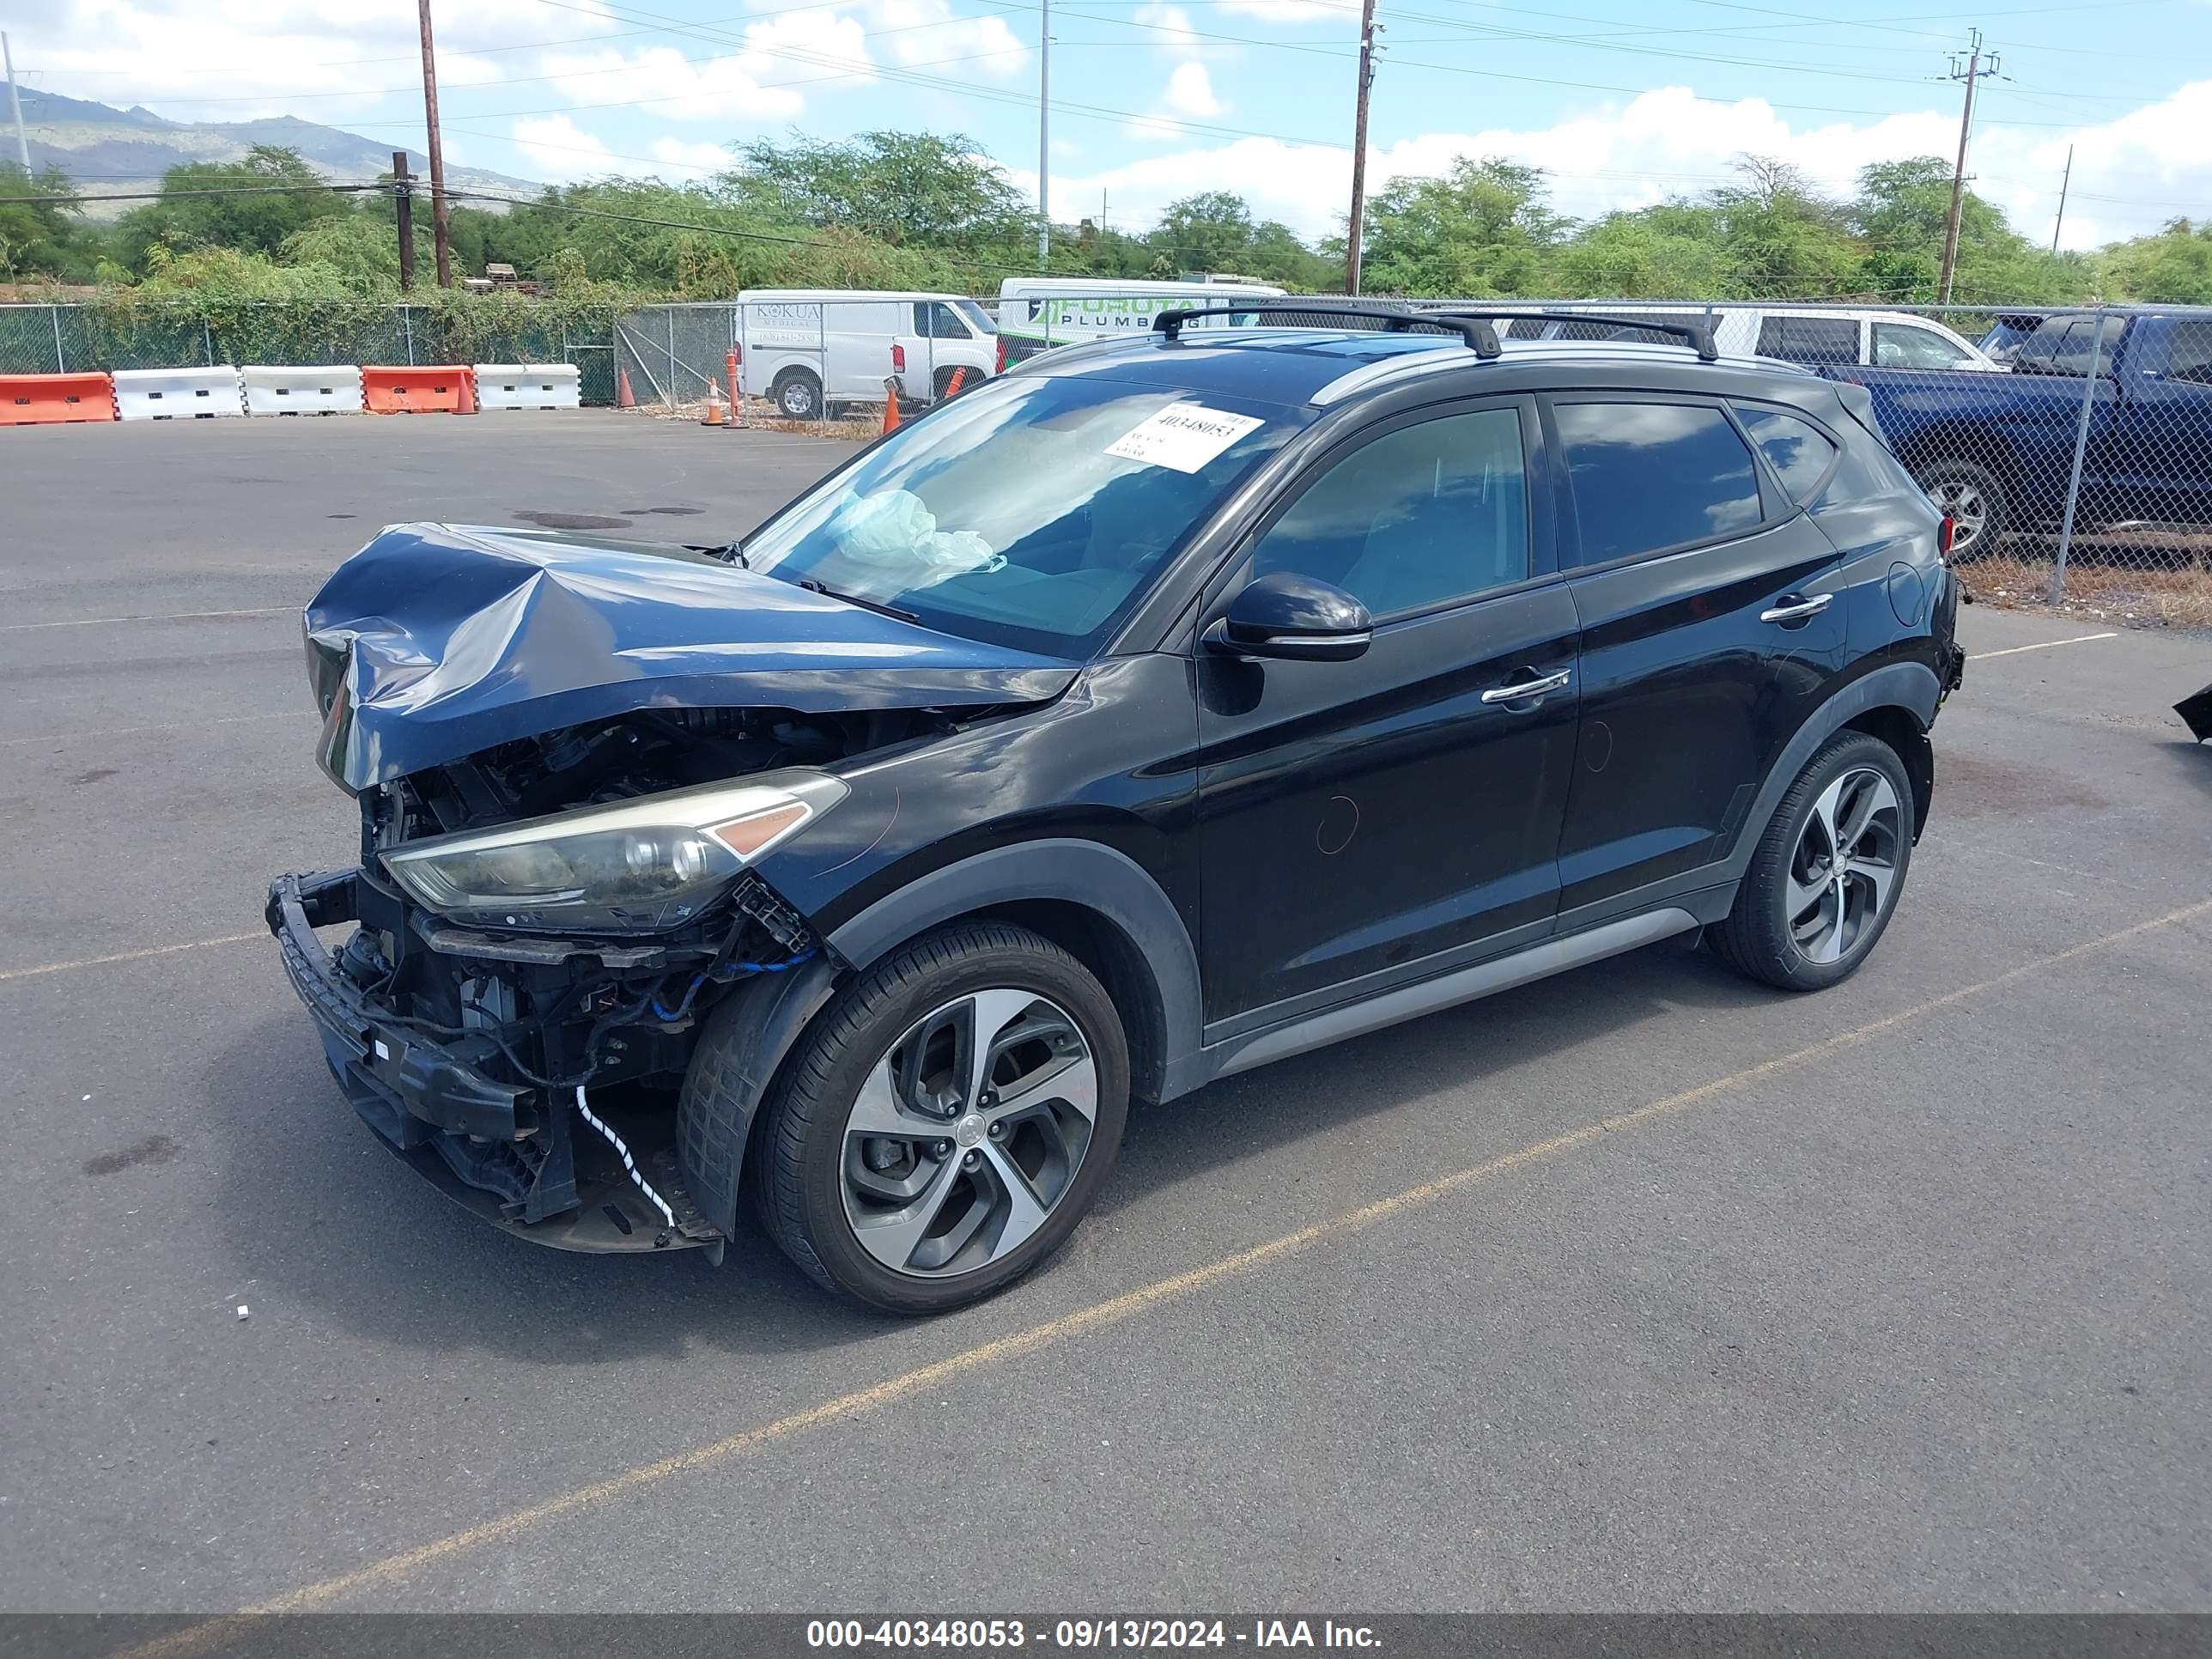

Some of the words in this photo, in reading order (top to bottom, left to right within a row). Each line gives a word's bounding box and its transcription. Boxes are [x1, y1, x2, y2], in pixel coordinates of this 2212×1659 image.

[757, 304, 820, 319] KOKUA
[1061, 316, 1200, 328] PLUMBG
[1158, 416, 1235, 437] 40348053
